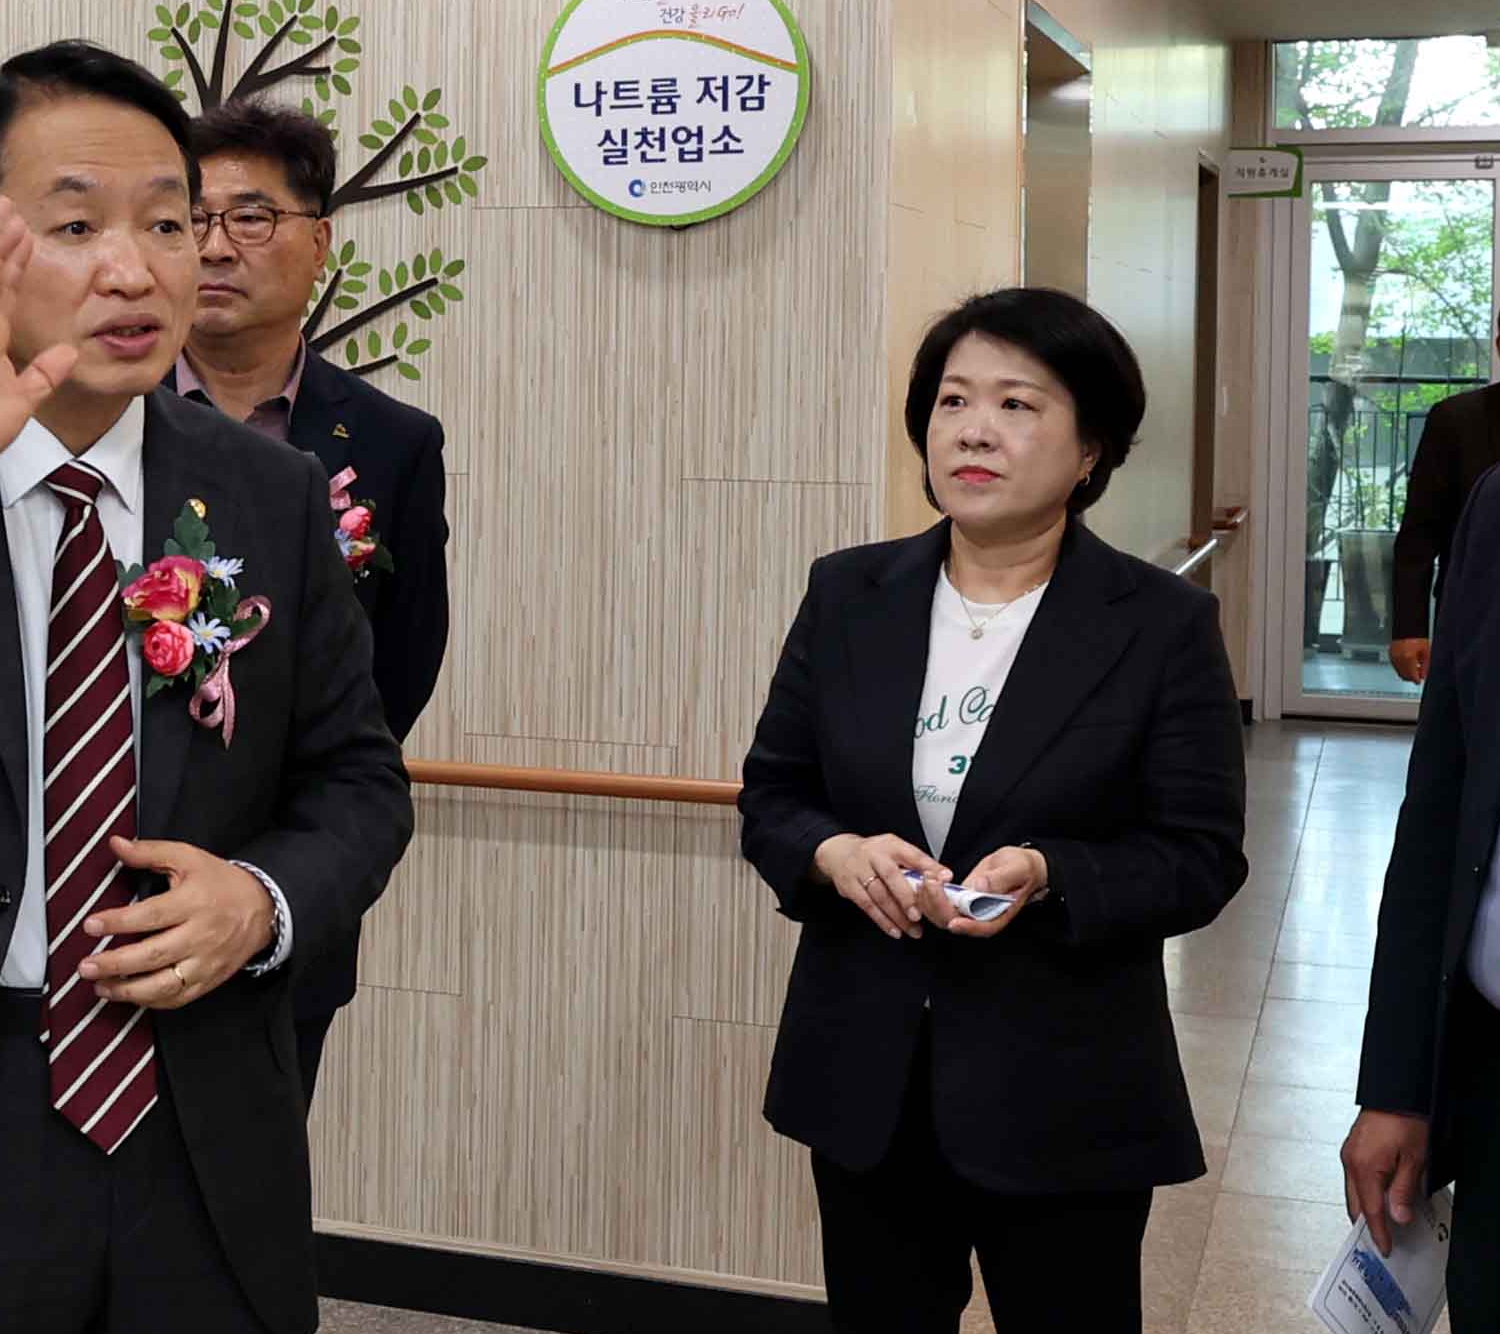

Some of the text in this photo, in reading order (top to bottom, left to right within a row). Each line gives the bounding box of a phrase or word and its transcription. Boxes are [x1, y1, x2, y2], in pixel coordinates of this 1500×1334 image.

[659, 7, 685, 24] 건강
[573, 74, 771, 117] 나트륨 저감
[597, 125, 744, 166] 실천업소
[650, 179, 712, 194] 인천광역시
